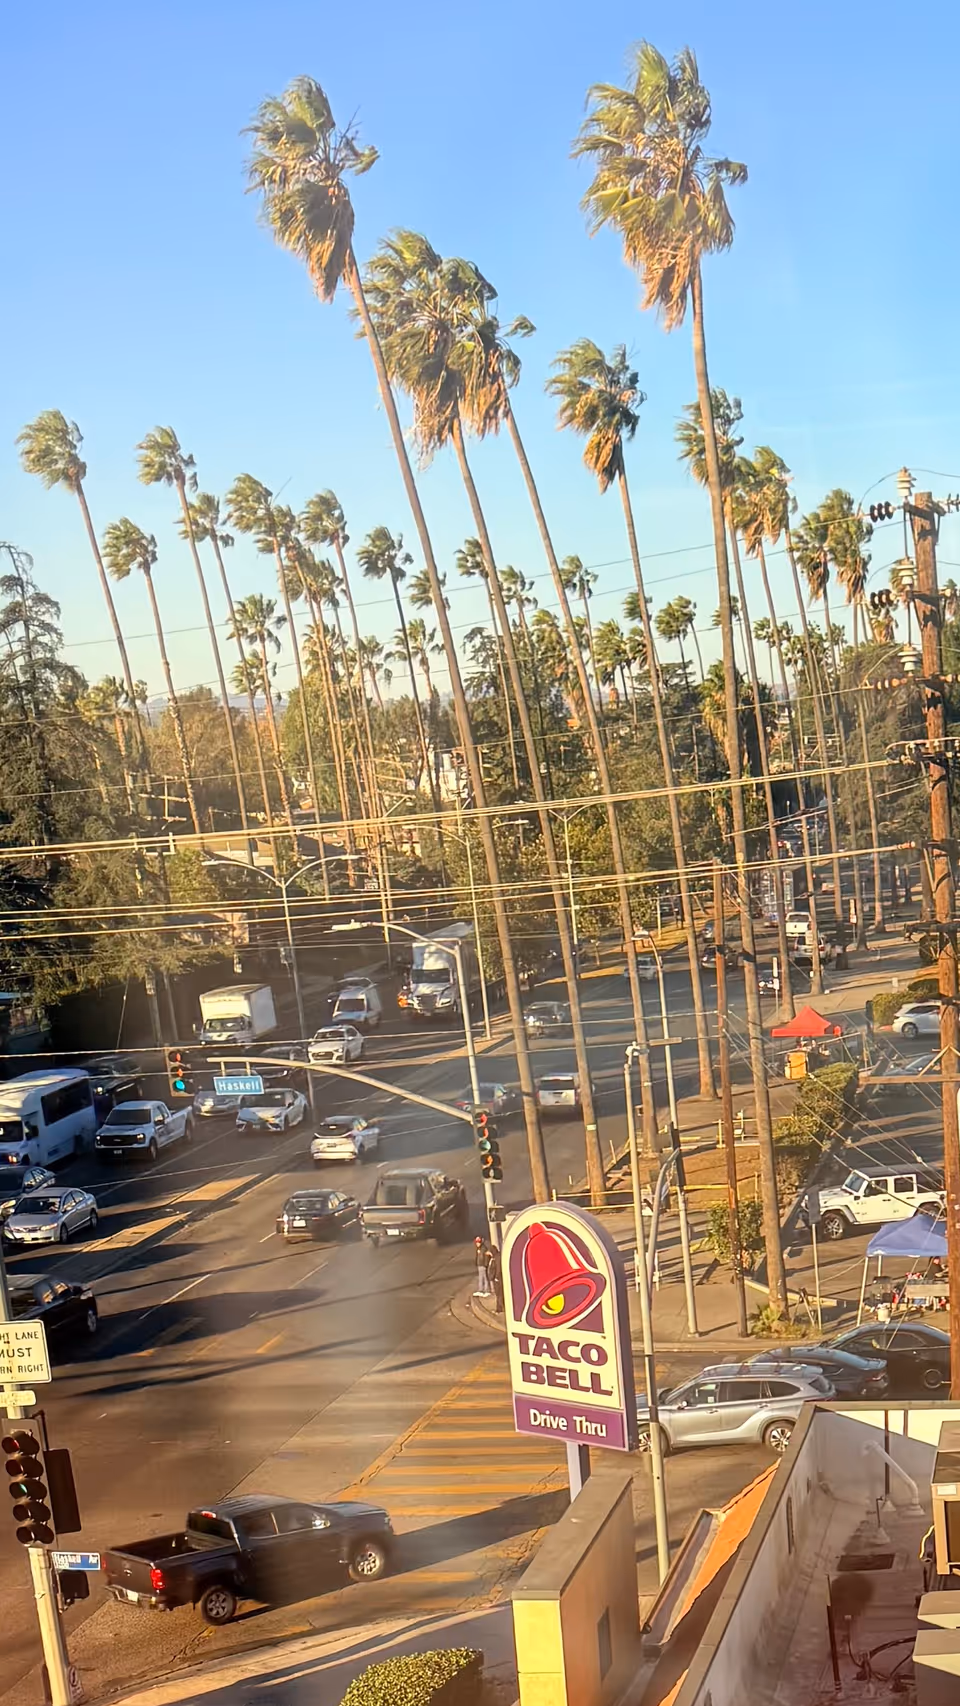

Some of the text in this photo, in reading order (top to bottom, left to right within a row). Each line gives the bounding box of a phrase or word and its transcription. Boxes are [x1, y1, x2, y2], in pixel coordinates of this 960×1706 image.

[218, 1081, 260, 1091] Haskell
[15, 1331, 39, 1341] LANE
[512, 1332, 608, 1366] TACO
[18, 1364, 44, 1373] RIGHT
[521, 1362, 613, 1396] BELL
[530, 1408, 607, 1438] Drive Thru
